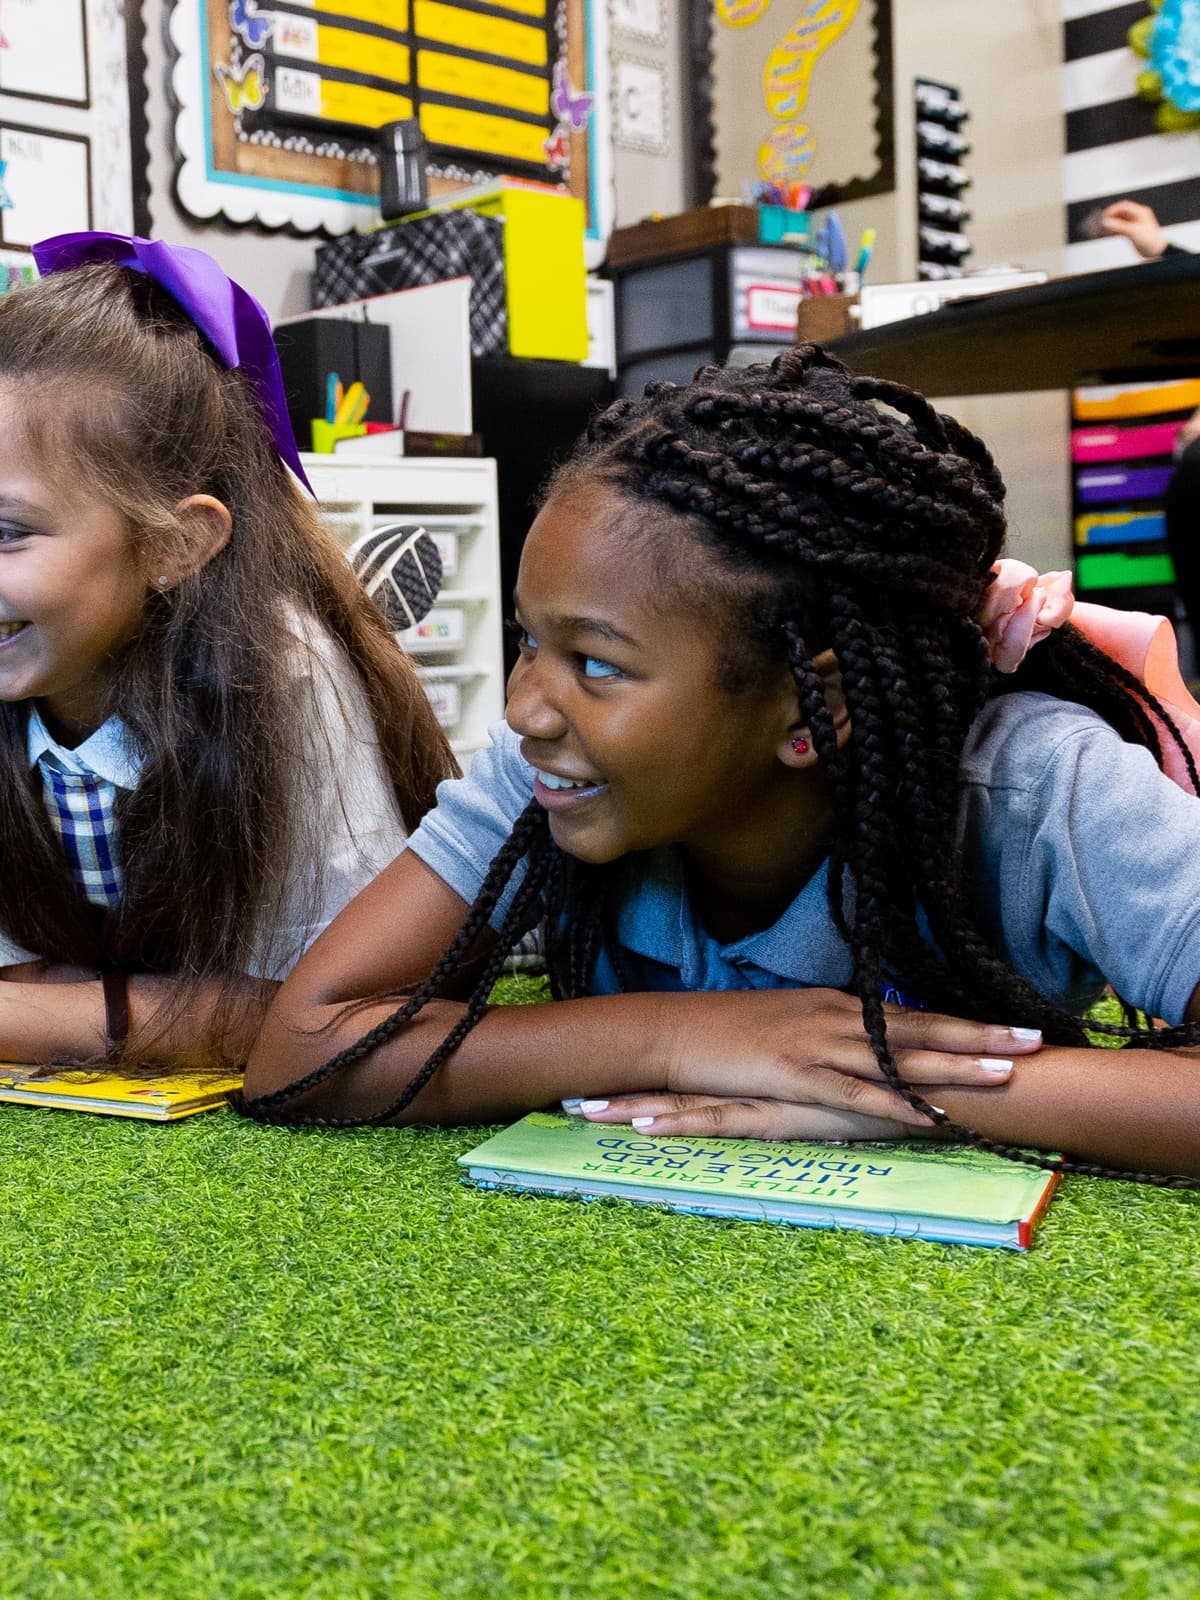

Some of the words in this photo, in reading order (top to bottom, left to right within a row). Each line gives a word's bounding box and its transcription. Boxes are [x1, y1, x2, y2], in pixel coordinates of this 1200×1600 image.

[595, 1138, 725, 1159] HOOD
[706, 1138, 834, 1161] lift-the-flap
[843, 1153, 857, 1161] a
[601, 1151, 690, 1169] RED
[738, 1153, 893, 1177] RIDING
[582, 1161, 725, 1185] CRITTER
[702, 1162, 859, 1186] LITTLE
[736, 1178, 860, 1199] LITTLE
